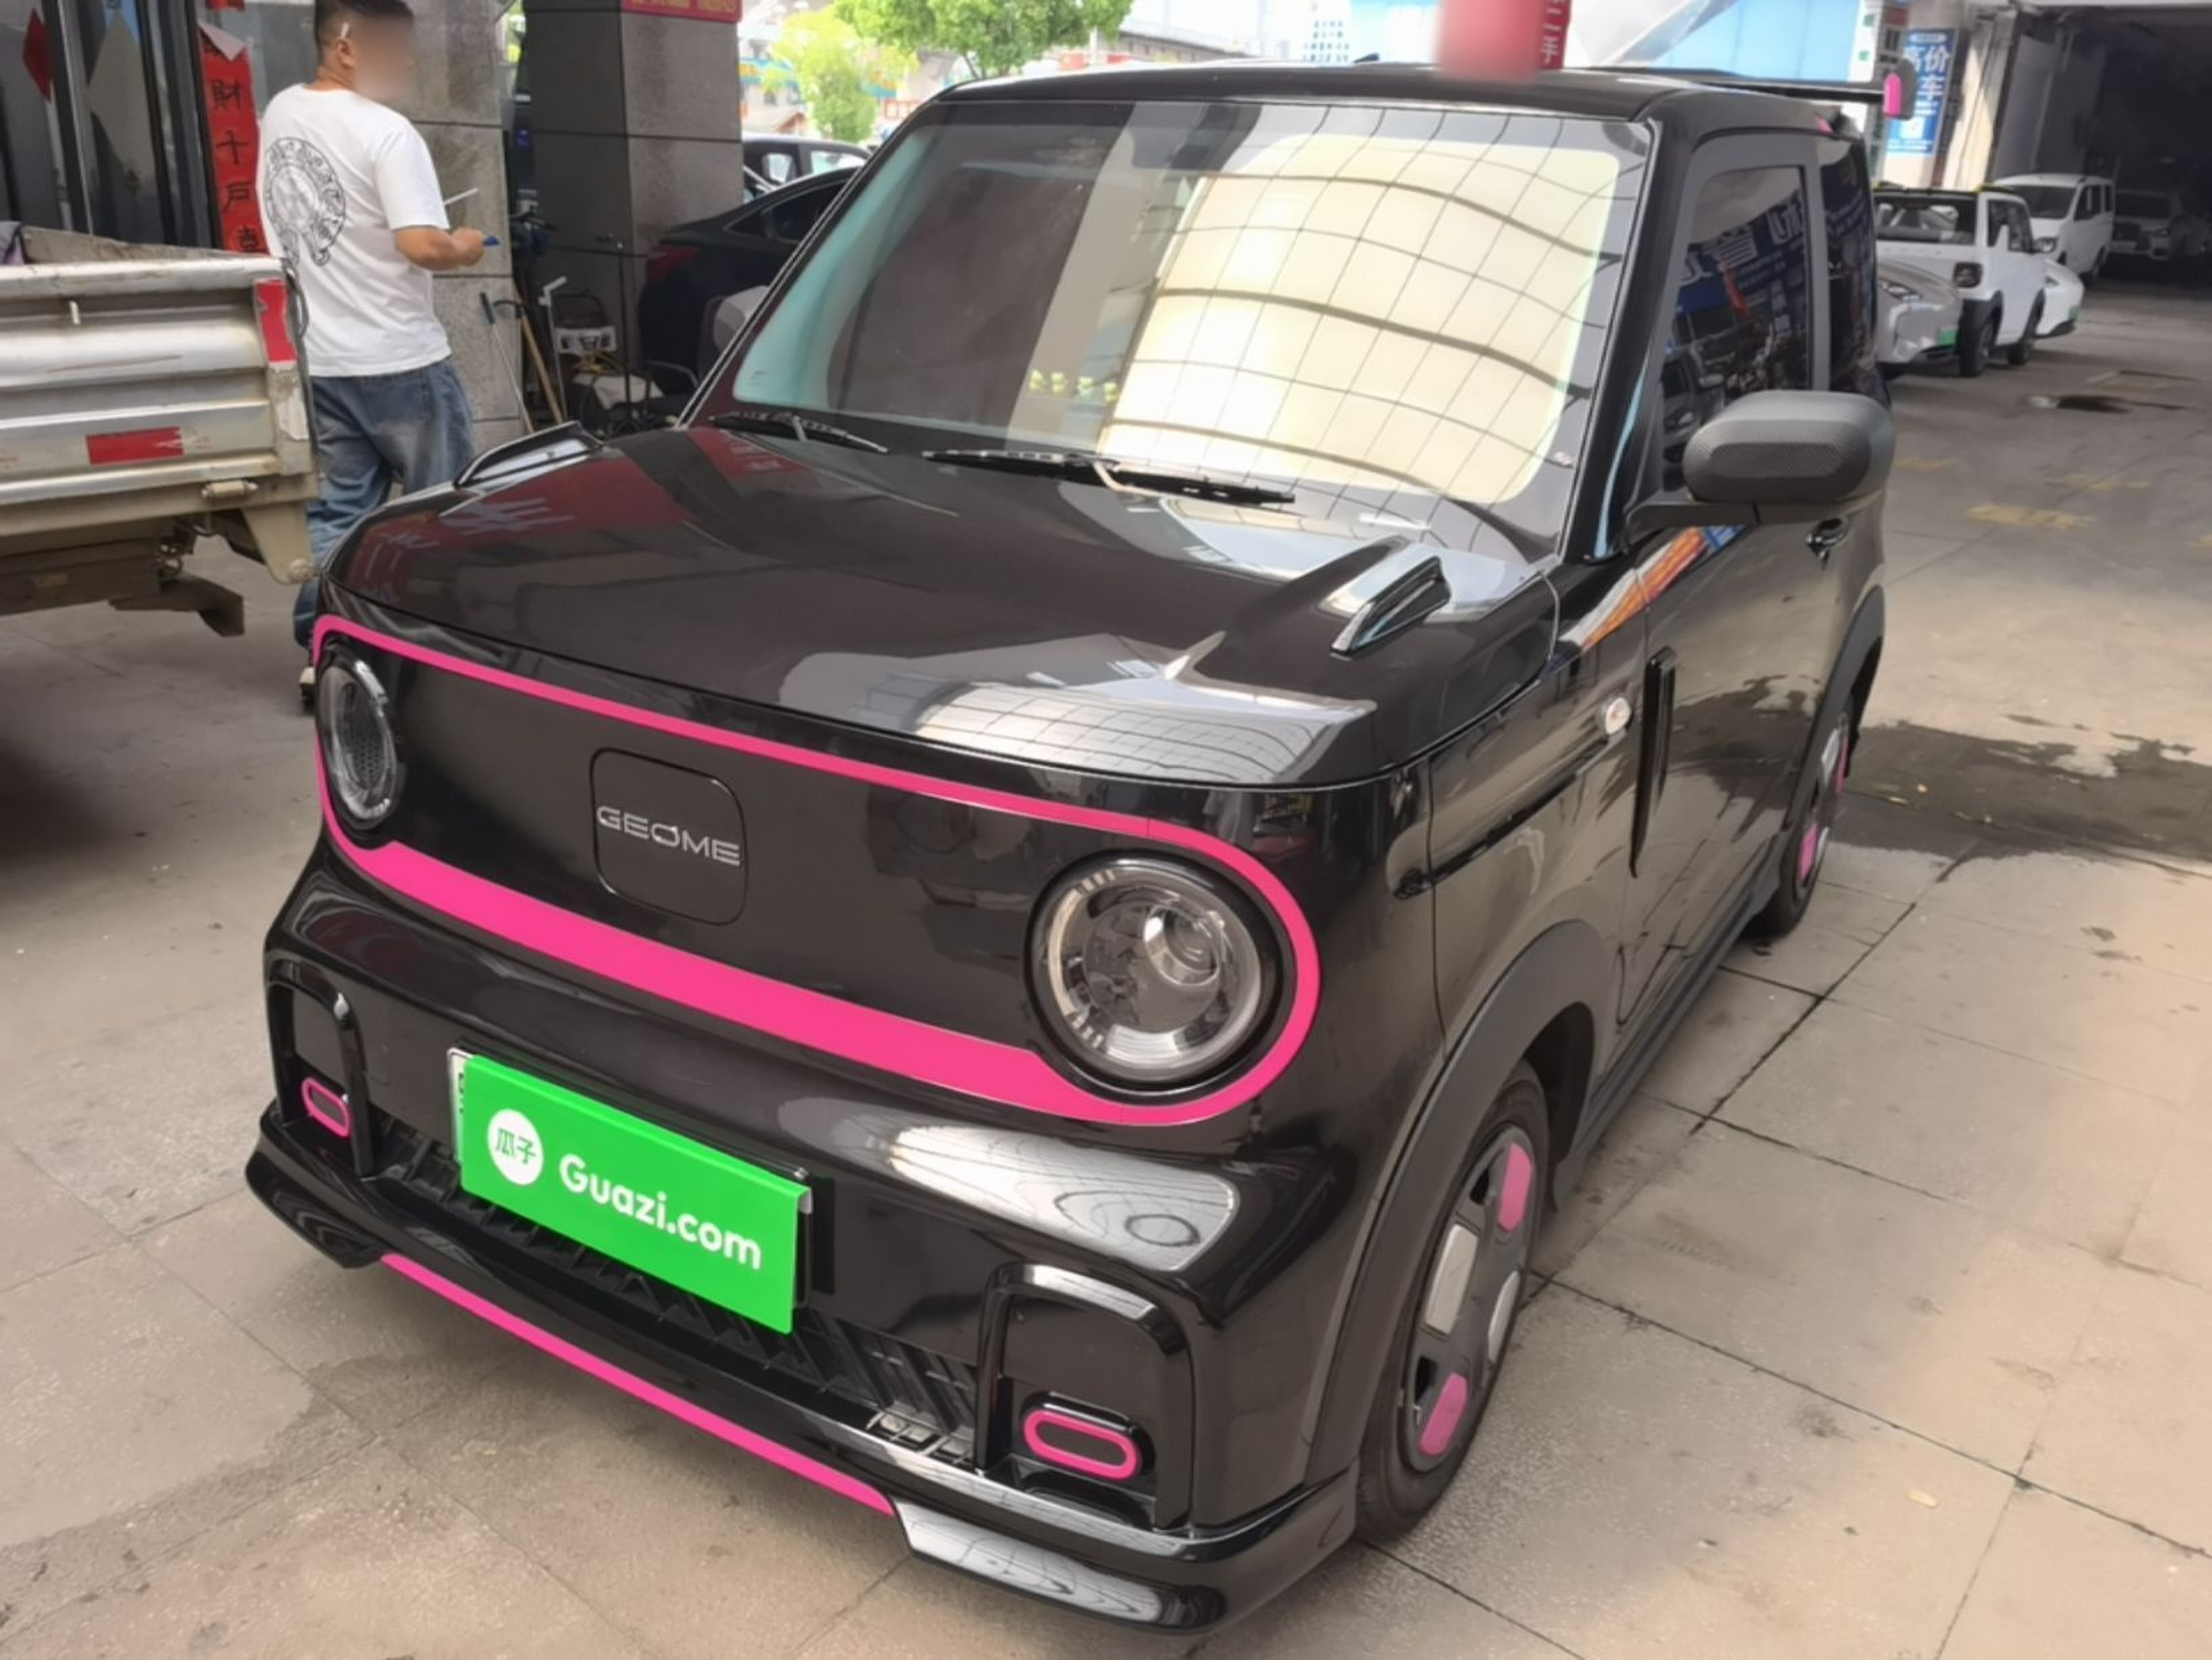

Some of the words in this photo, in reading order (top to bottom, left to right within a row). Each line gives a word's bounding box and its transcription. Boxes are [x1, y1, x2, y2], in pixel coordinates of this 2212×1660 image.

[1540, 0, 1564, 65] 二手
[1916, 73, 1946, 100] 车
[597, 806, 740, 866] GEOME
[495, 1128, 536, 1164] 瓜子
[559, 1154, 761, 1270] Guazi.com
